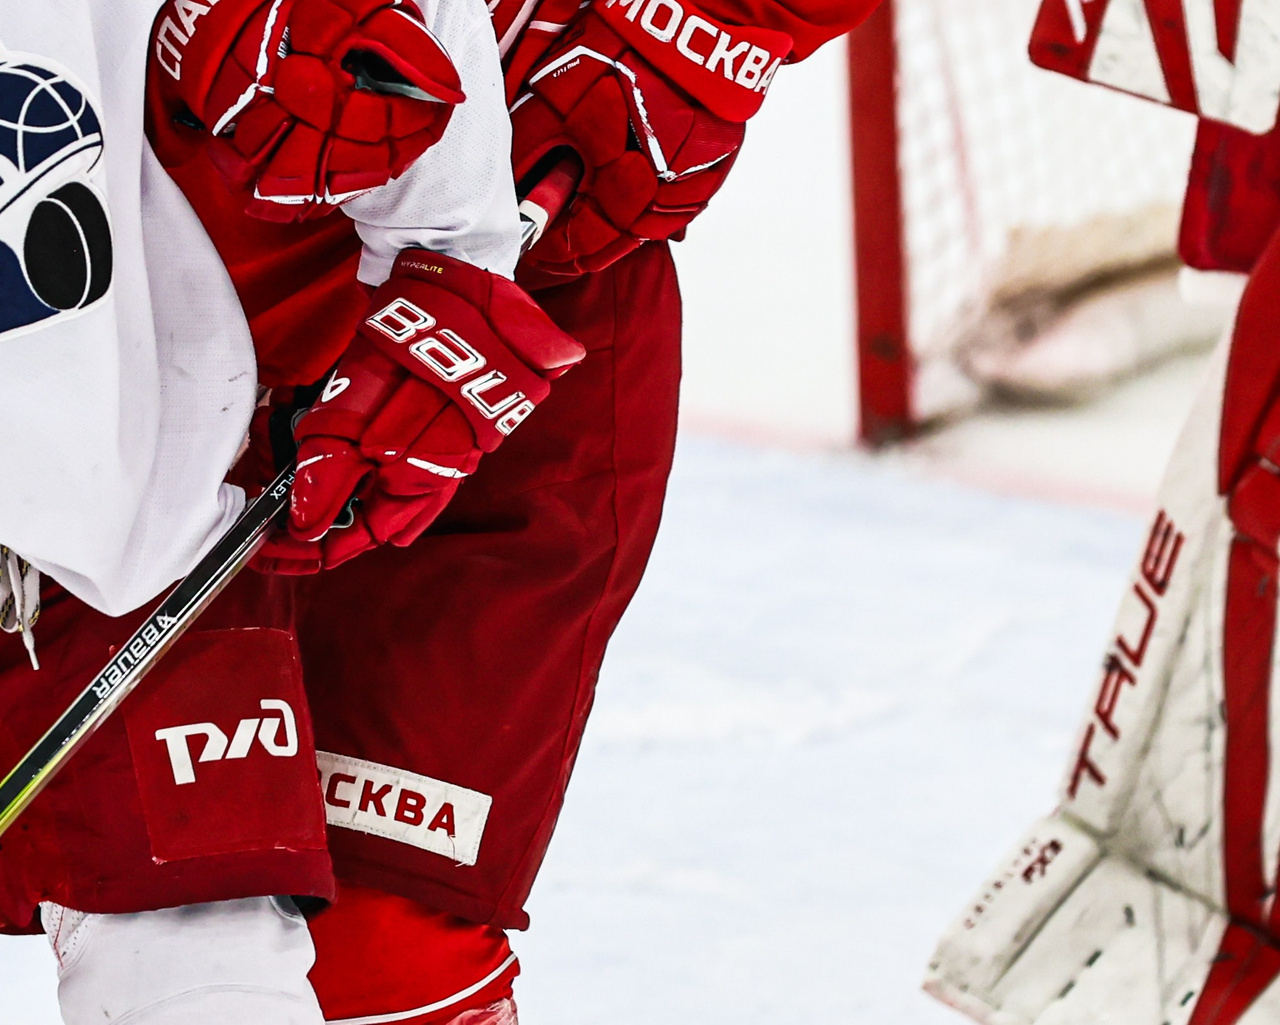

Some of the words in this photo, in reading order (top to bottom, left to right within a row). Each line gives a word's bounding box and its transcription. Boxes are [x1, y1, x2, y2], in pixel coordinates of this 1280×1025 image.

[400, 259, 445, 275] HYPERLITE
[269, 474, 296, 500] FLEX
[1067, 509, 1185, 801] TRUE
